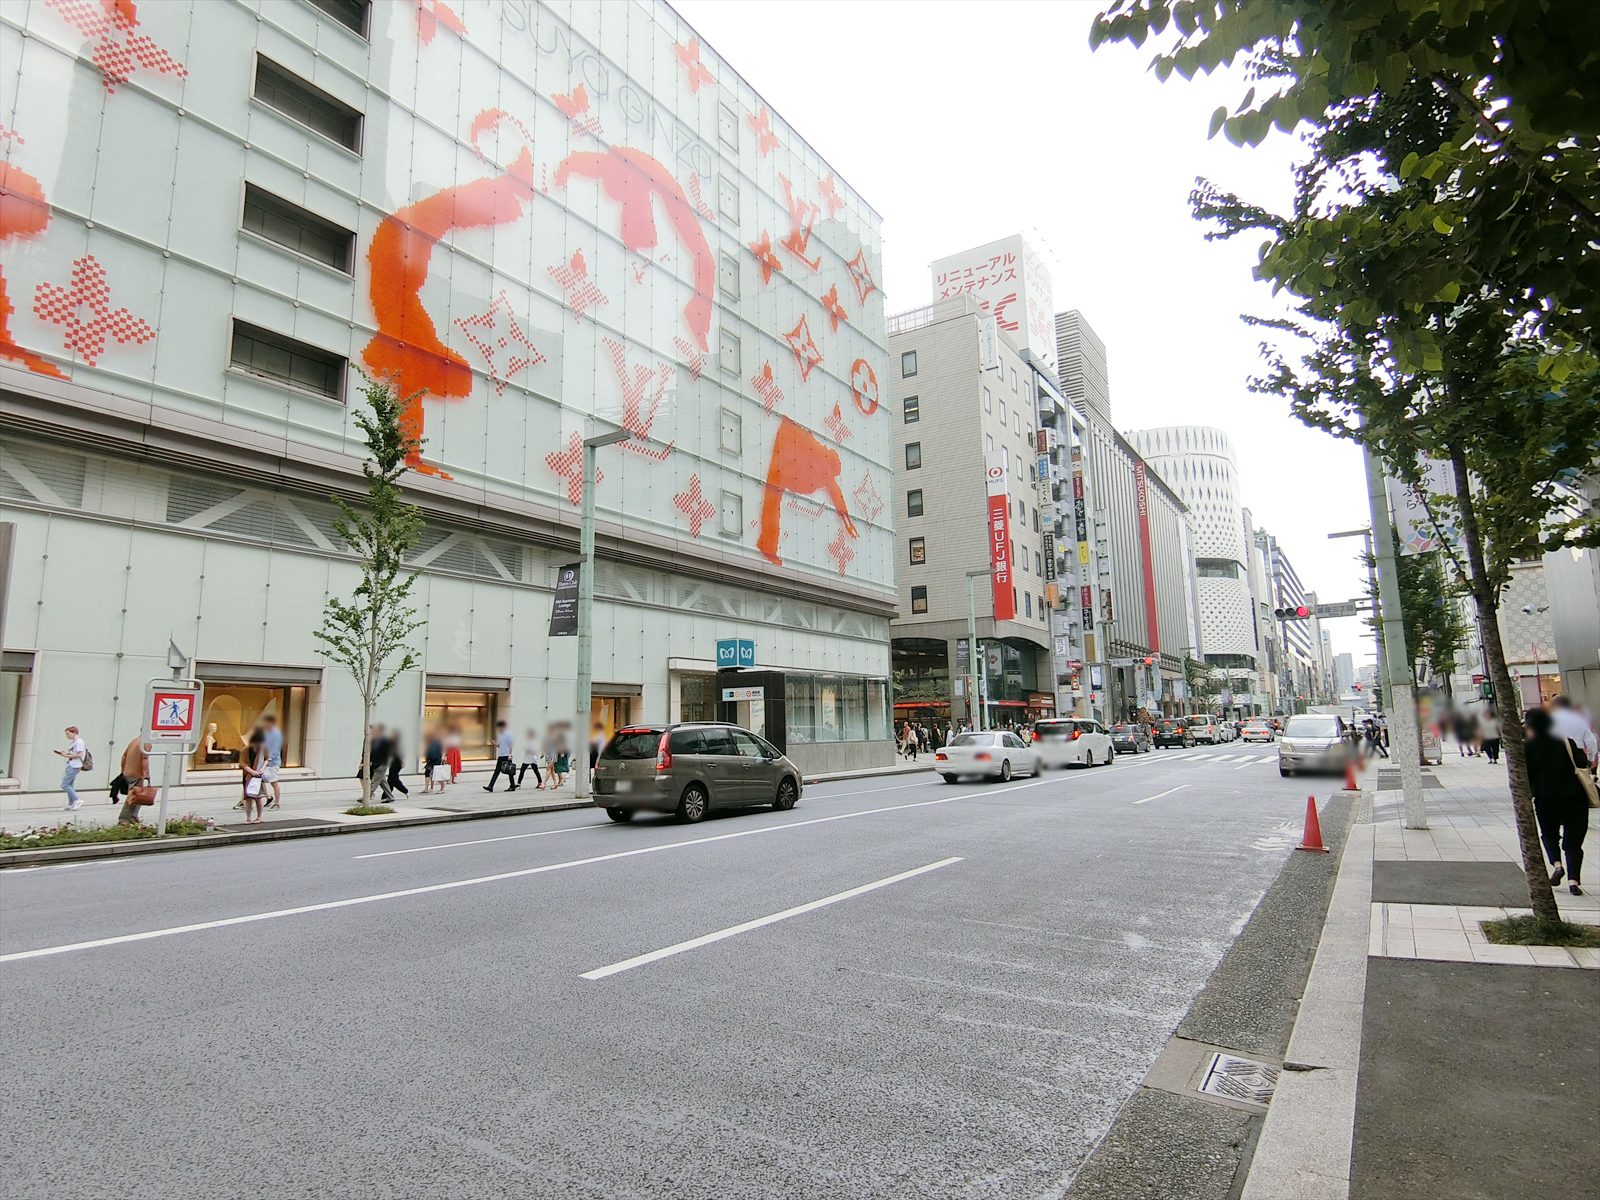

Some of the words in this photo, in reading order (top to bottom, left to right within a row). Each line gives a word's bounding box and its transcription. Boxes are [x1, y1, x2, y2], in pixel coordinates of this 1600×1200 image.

[937, 252, 1016, 286] リニューアル
[940, 267, 1017, 300] メンテナンス
[1135, 465, 1146, 516] MITSUKOSHI
[993, 508, 1008, 583] 三菱UFJ銀行
